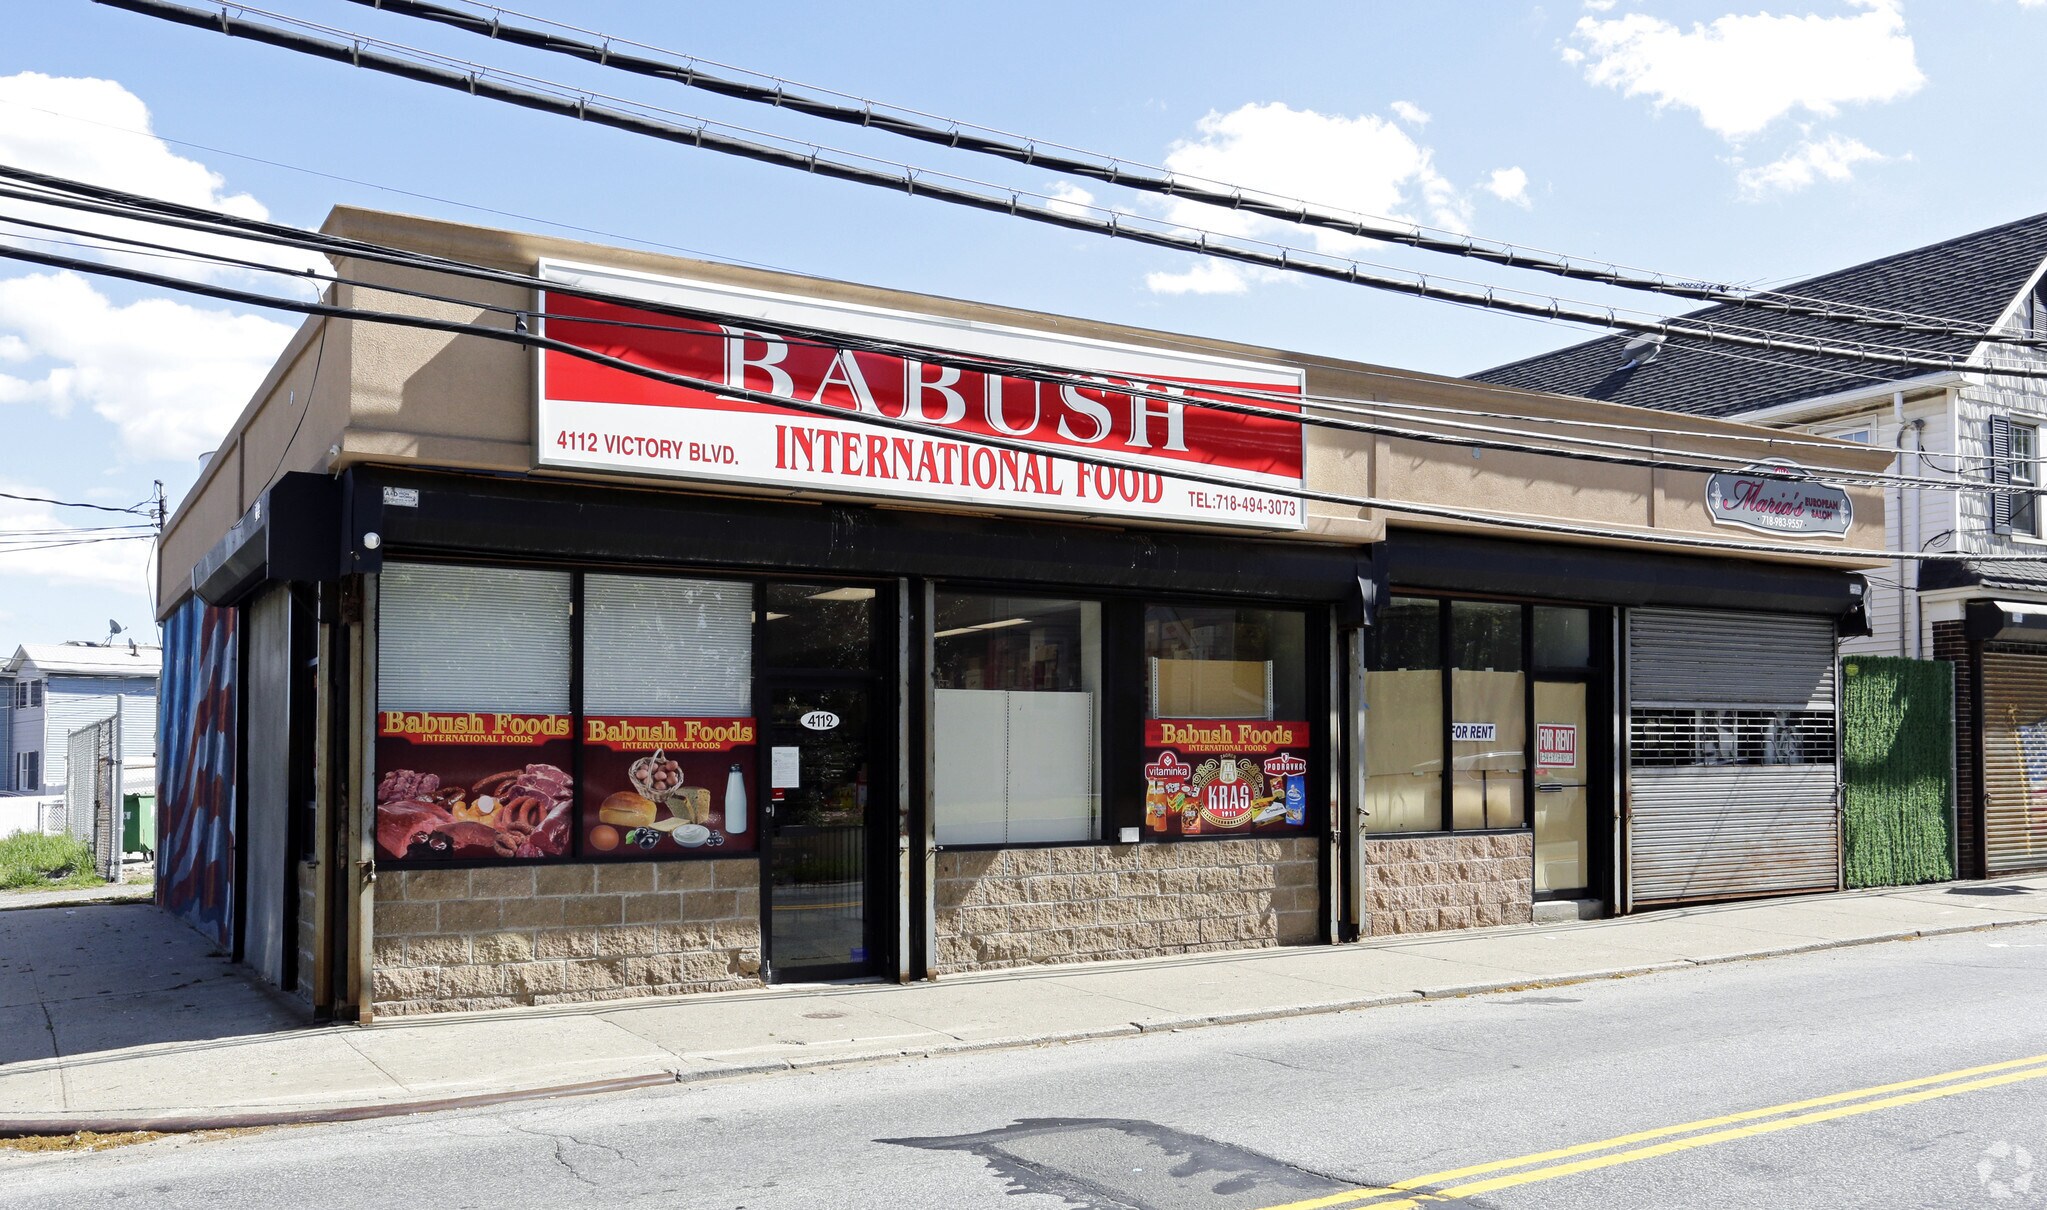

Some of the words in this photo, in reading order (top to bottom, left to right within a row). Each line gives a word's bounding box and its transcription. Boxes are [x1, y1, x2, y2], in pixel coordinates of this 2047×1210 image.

[715, 324, 1190, 452] BABUSH
[557, 430, 597, 452] 4112
[604, 434, 683, 461] VICTORY
[689, 443, 739, 465] BLVD.
[775, 425, 1063, 495] INTERNATIONAL
[1077, 461, 1163, 504] FOOD
[1188, 491, 1296, 517] TEL:718-494-3073
[1723, 479, 1805, 517] Maria's
[1804, 497, 1839, 510] EUROPEAN
[384, 712, 485, 734] Babush
[492, 713, 570, 736] Foods
[587, 720, 677, 742] Babush
[684, 721, 753, 742] Foods
[808, 714, 833, 727] 4112
[422, 734, 498, 743] INTERNATIONAL
[501, 735, 533, 743] FOODS
[1161, 723, 1233, 744] Babush
[1238, 724, 1293, 744] Foods
[1470, 726, 1493, 739] RENT
[1540, 729, 1553, 750] FOR
[1556, 729, 1574, 751] RENT
[622, 741, 690, 749] INTERNATIONAL
[1149, 767, 1188, 776] vitaminka
[1267, 763, 1304, 771] PODRAVKA
[1208, 782, 1249, 810] KRAŠ
